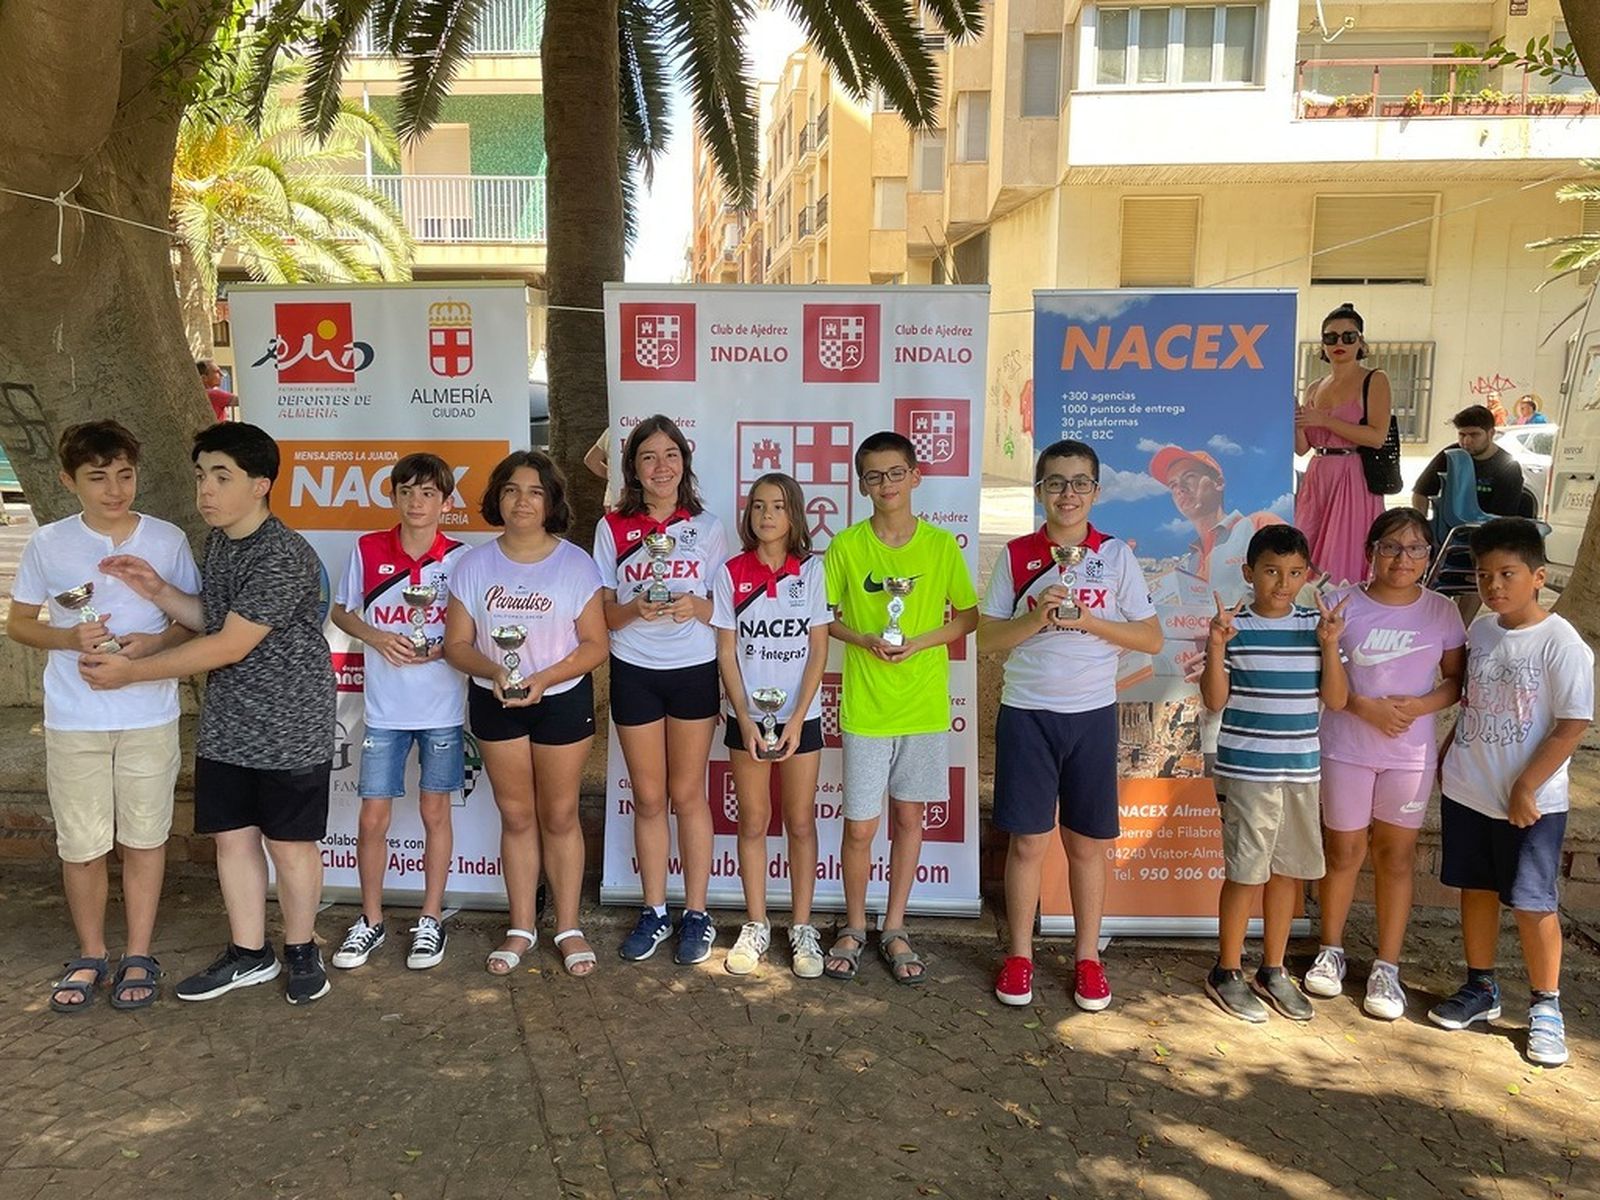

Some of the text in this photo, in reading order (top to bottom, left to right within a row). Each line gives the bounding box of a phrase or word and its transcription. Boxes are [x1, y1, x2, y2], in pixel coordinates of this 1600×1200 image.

[711, 324, 788, 337] Club de Ajedrez
[895, 324, 973, 338] Club de Ajedrez
[1060, 324, 1269, 370] NACEX
[711, 346, 788, 363] INDALO
[895, 346, 972, 364] INDALO
[277, 395, 371, 406] DEPORTES DE
[410, 384, 493, 404] ALMERÍA
[1062, 391, 1136, 403] +300 agencias
[432, 407, 476, 418] CIUDAD
[1062, 404, 1185, 416] 1000 puntos de entrega
[675, 416, 696, 428] drez
[1062, 417, 1139, 429] 30 plataformas
[1061, 430, 1083, 440] B2C
[1092, 430, 1114, 440] B2C
[294, 450, 353, 462] MENSAJEROS
[354, 451, 366, 461] LA
[290, 466, 470, 509] NACX
[438, 512, 469, 525] MERÍA
[932, 511, 968, 525] Ajedrez
[485, 585, 552, 612] Paradise
[740, 617, 810, 638] NACEX
[1363, 628, 1417, 650] NIKE
[822, 783, 834, 793] de
[1118, 804, 1221, 817] NACEX Almer
[1157, 826, 1174, 838] de
[1178, 825, 1221, 838] Filabre
[404, 839, 424, 850] con
[1106, 847, 1225, 860] 04240 Viator-Alme
[320, 850, 357, 868] Club
[458, 855, 501, 876] Indal
[1113, 868, 1135, 881] Tel.
[1140, 868, 1170, 880] 950
[1174, 867, 1203, 880] 306
